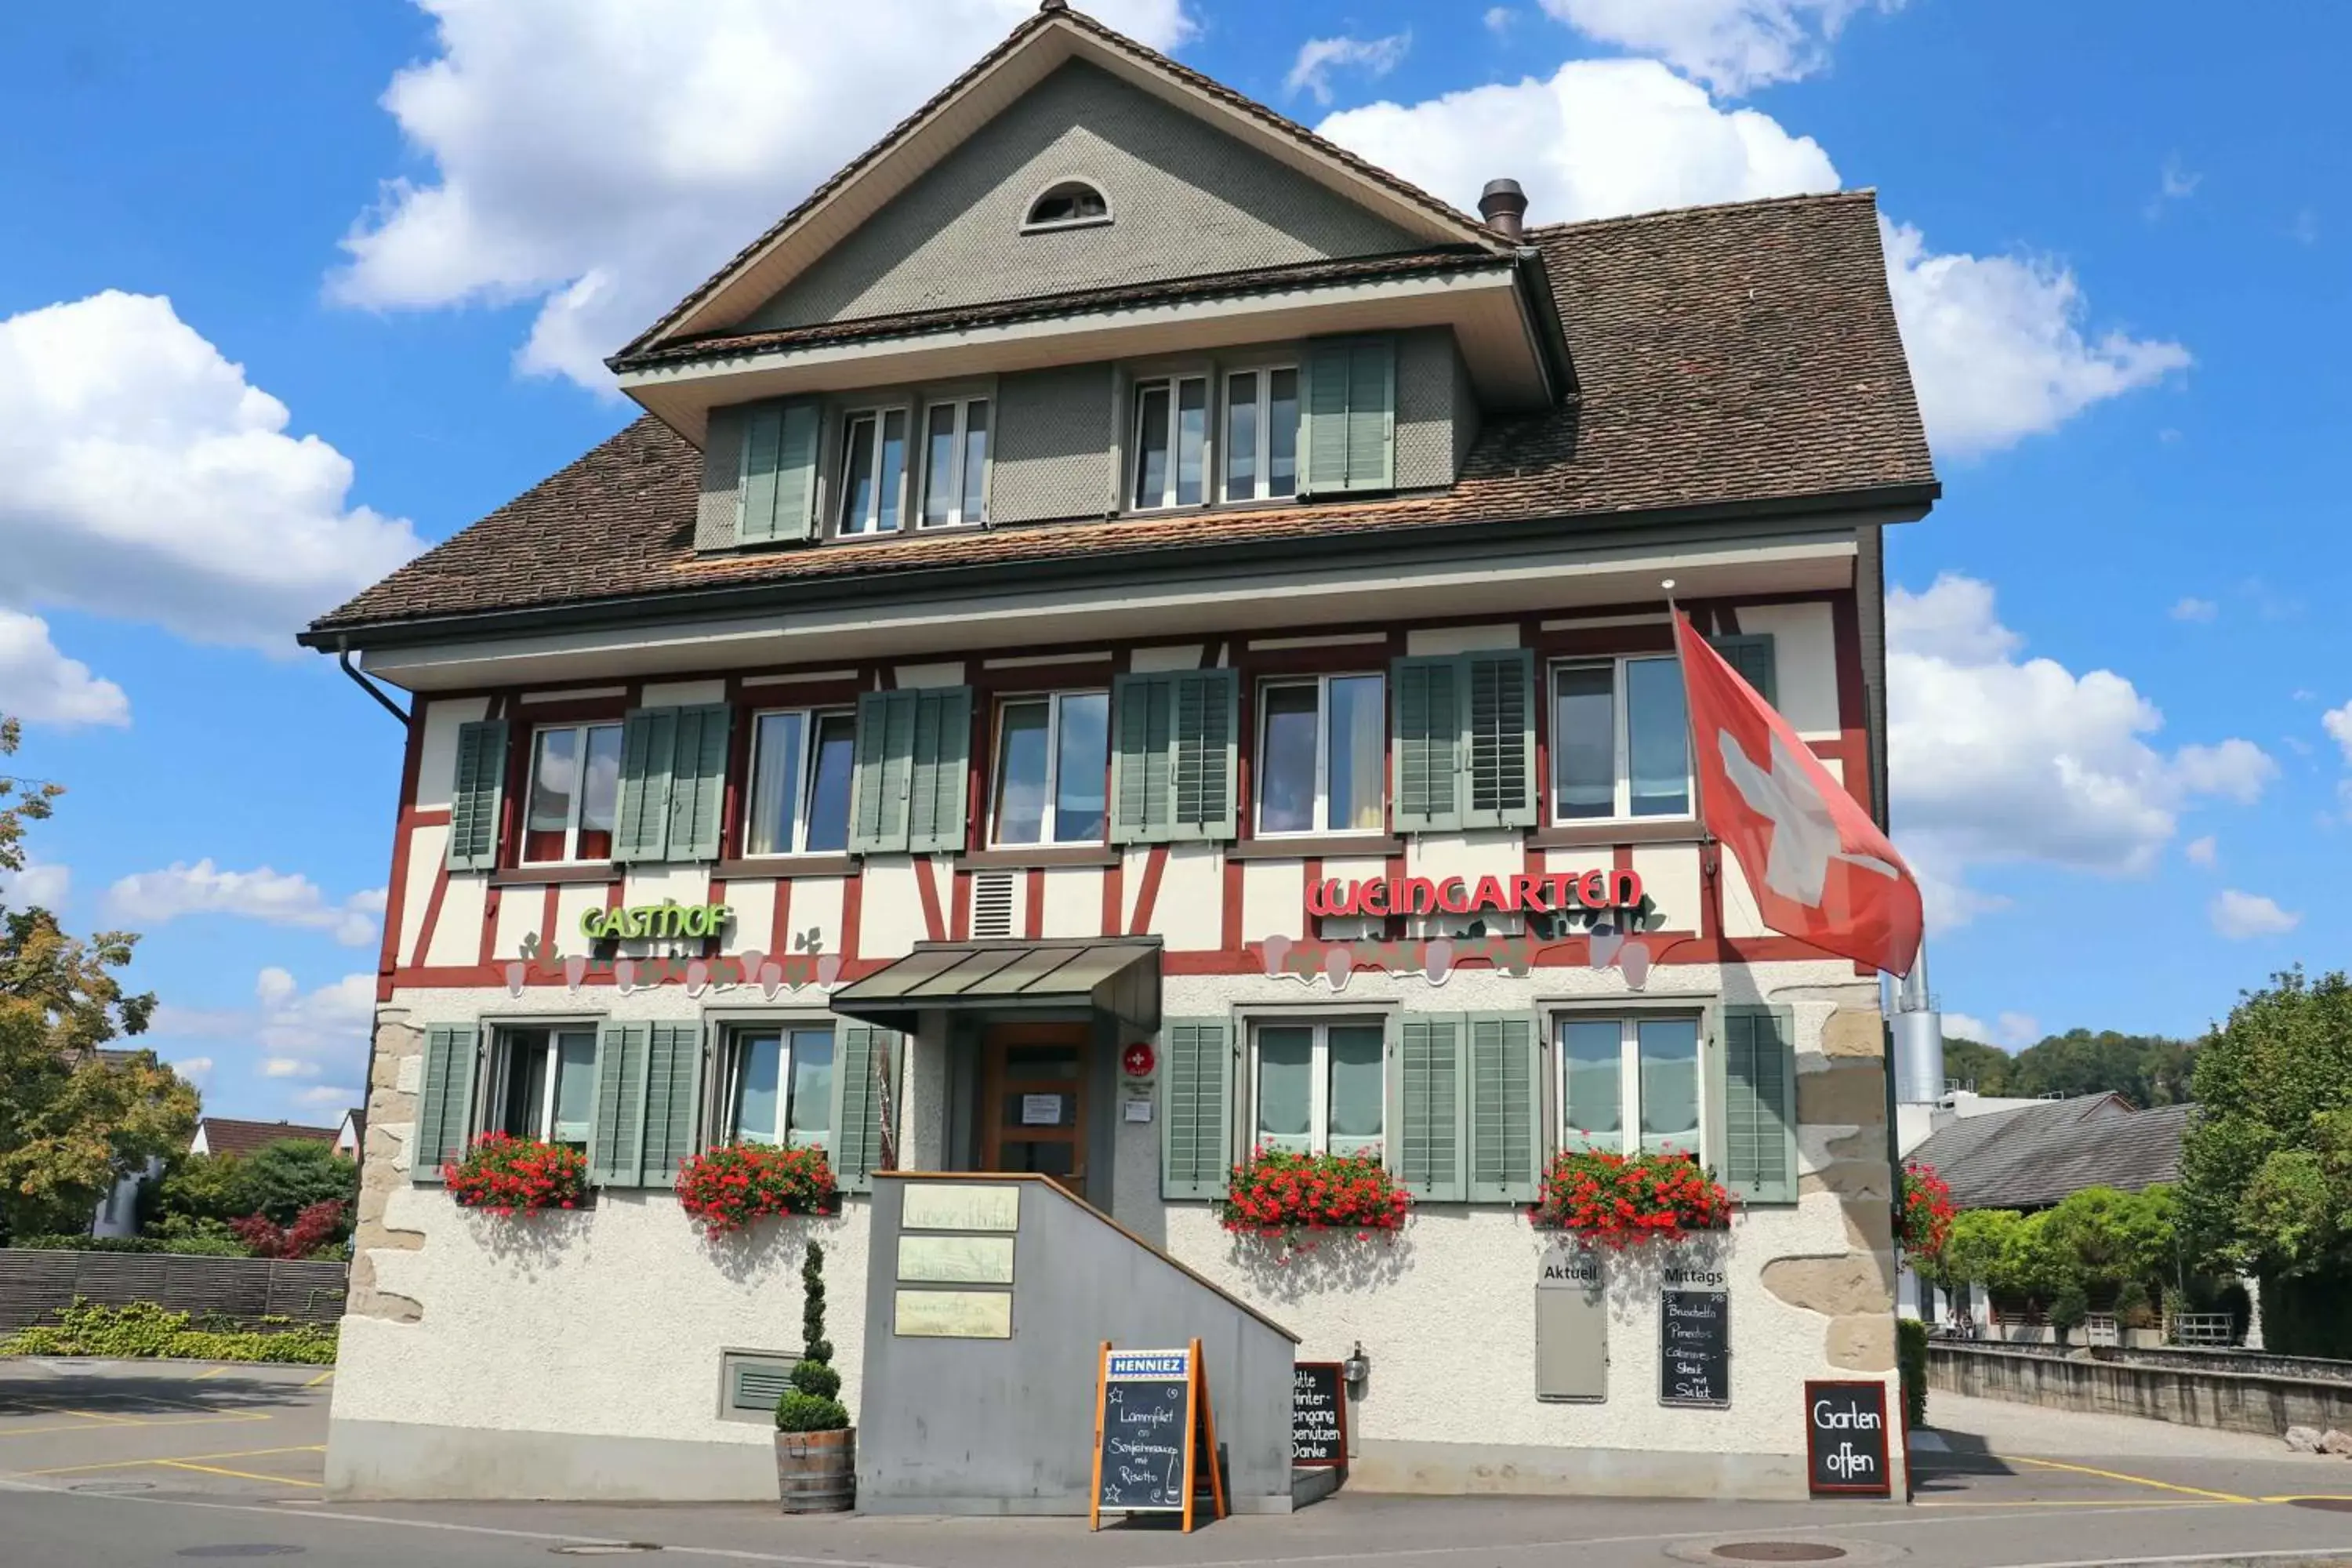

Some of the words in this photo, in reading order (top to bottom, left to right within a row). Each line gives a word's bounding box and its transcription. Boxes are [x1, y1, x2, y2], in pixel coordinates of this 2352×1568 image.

[1305, 869, 1644, 916] WEINGARTEN
[1544, 1265, 1598, 1280] Aktuell
[1664, 1268, 1723, 1287] Mittags
[1116, 1359, 1180, 1372] HENNIEZ
[1813, 1399, 1881, 1429] Garten
[1827, 1442, 1874, 1479] offen
[1120, 1465, 1158, 1486] Risotto
